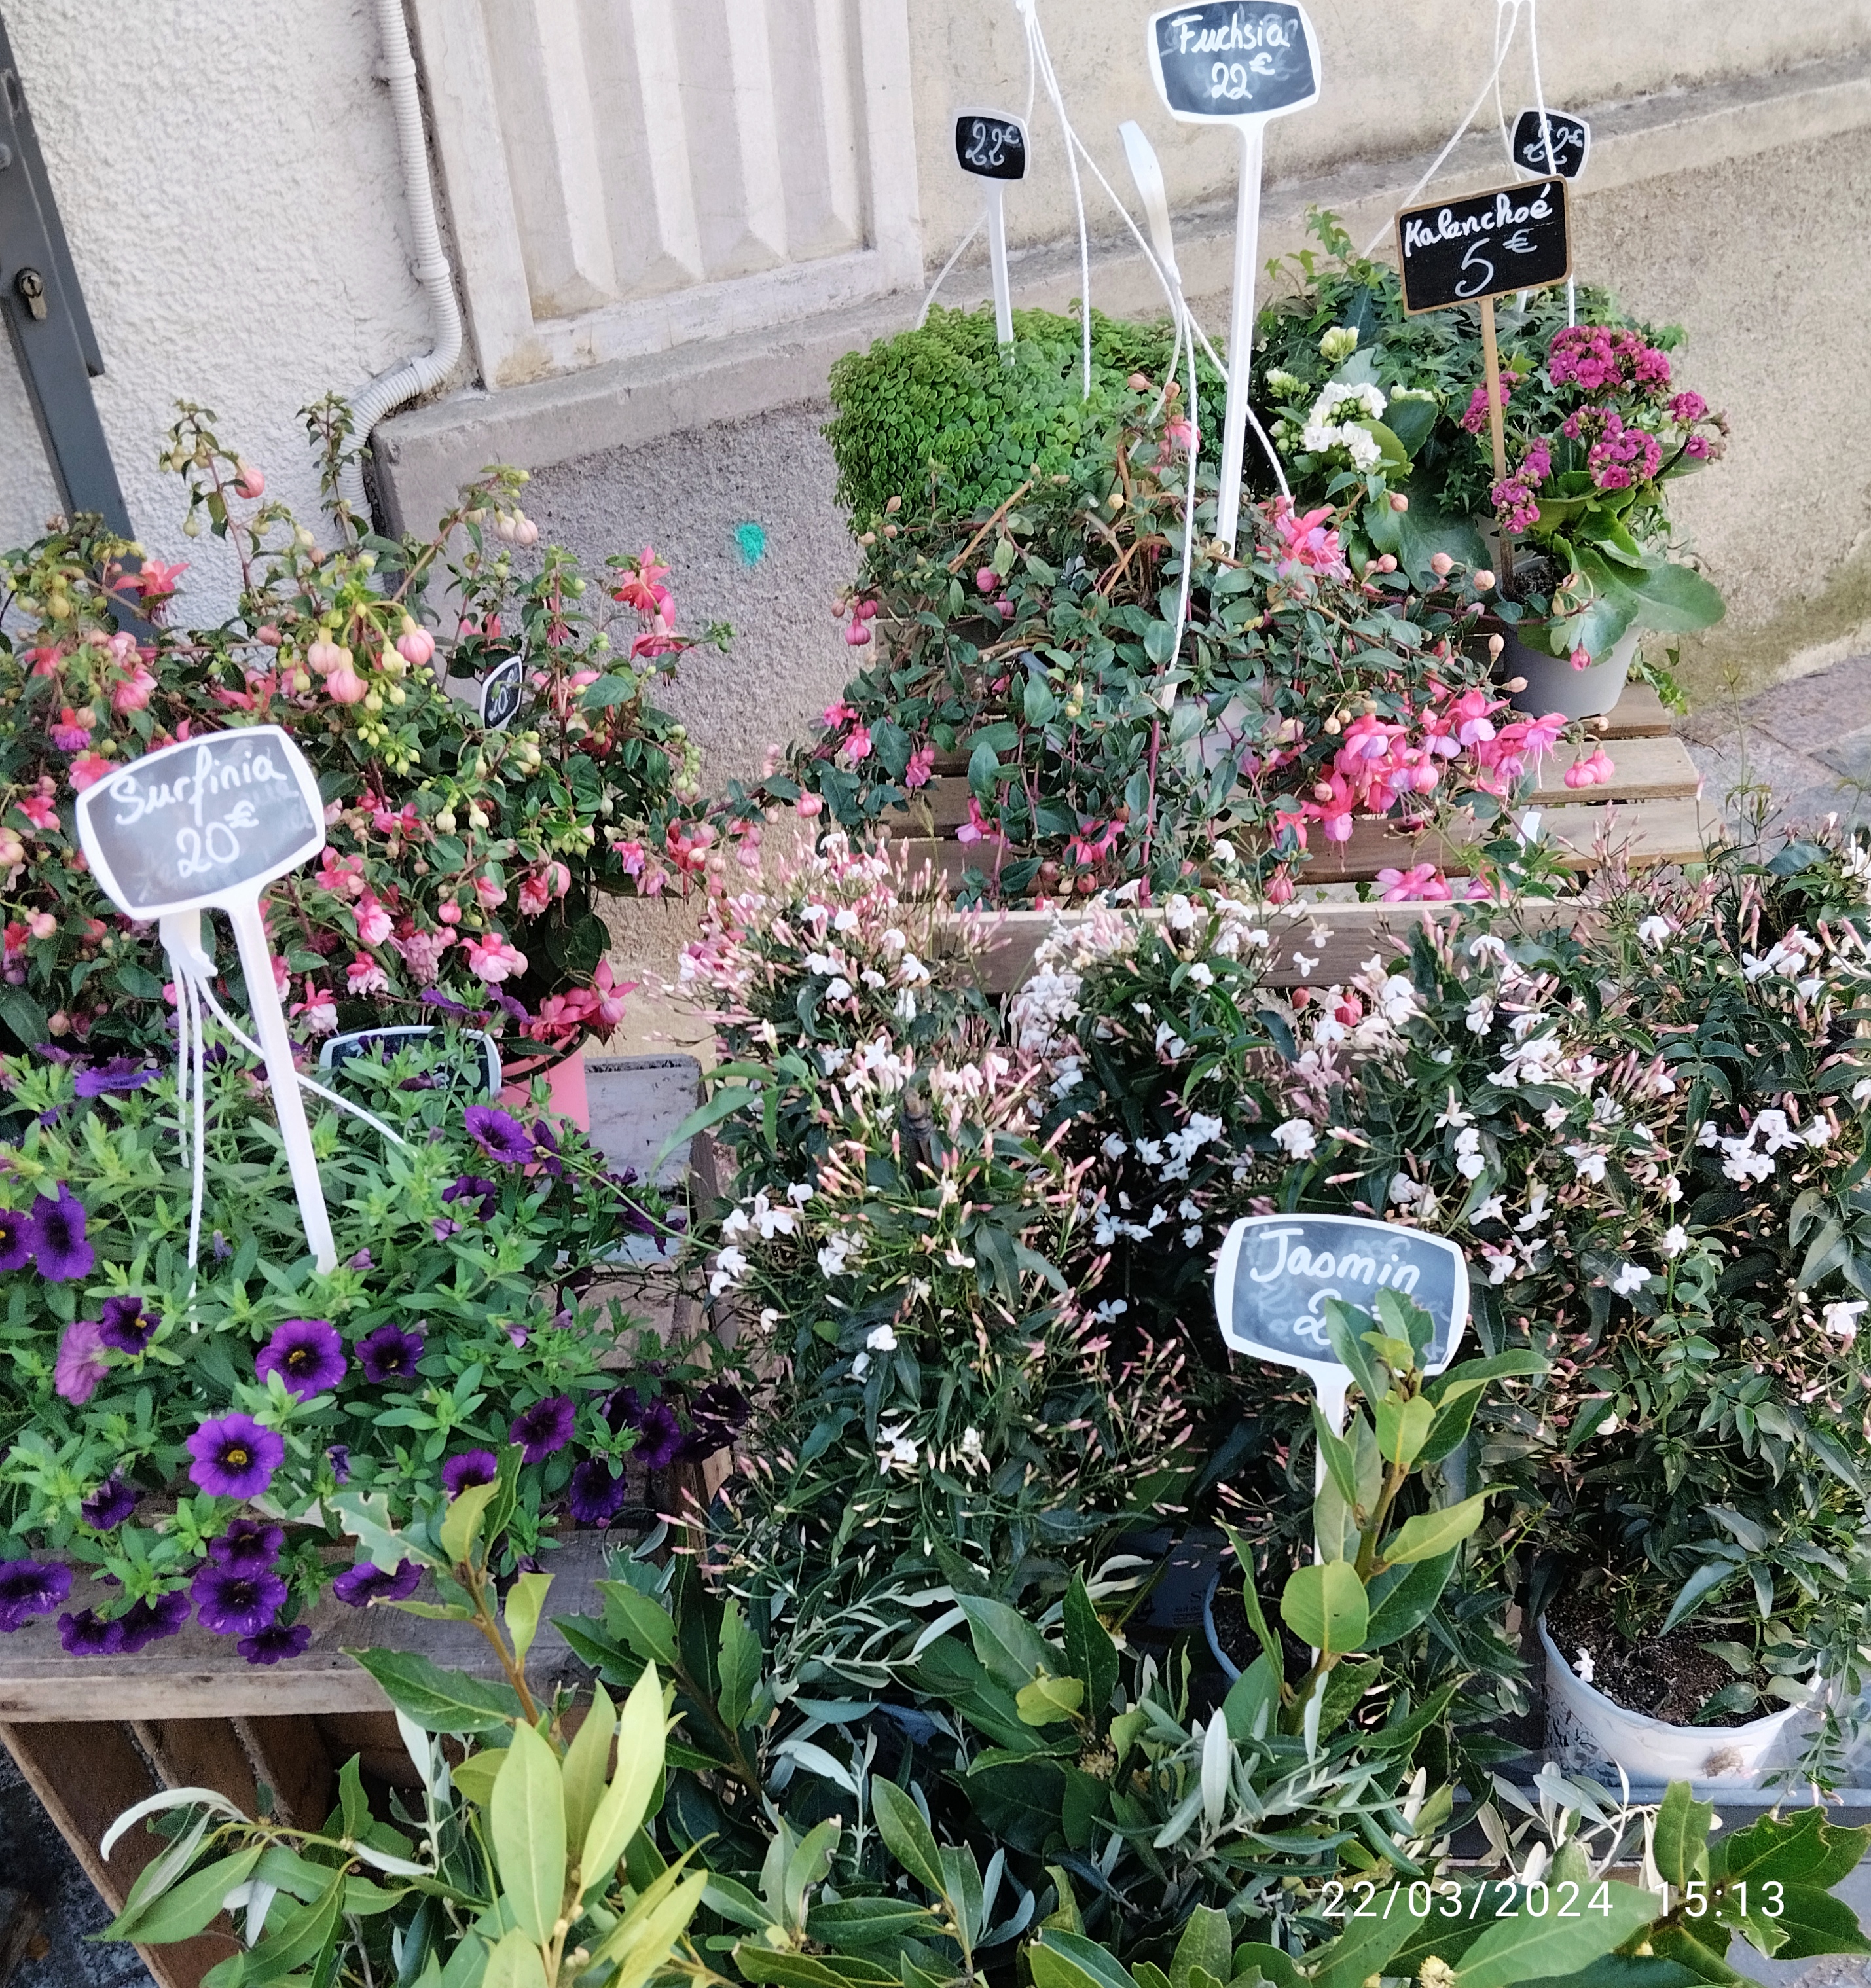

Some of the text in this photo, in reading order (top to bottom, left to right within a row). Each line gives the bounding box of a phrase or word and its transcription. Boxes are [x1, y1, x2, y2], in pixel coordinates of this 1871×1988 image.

[1171, 12, 1291, 54] Fuchsia
[1210, 52, 1276, 100] 22€
[965, 122, 1019, 166] 22€
[1404, 182, 1553, 258] Kalanchoé
[109, 744, 287, 827] Surfinia
[175, 799, 260, 878] 20€
[1250, 1227, 1421, 1295] Jasmin
